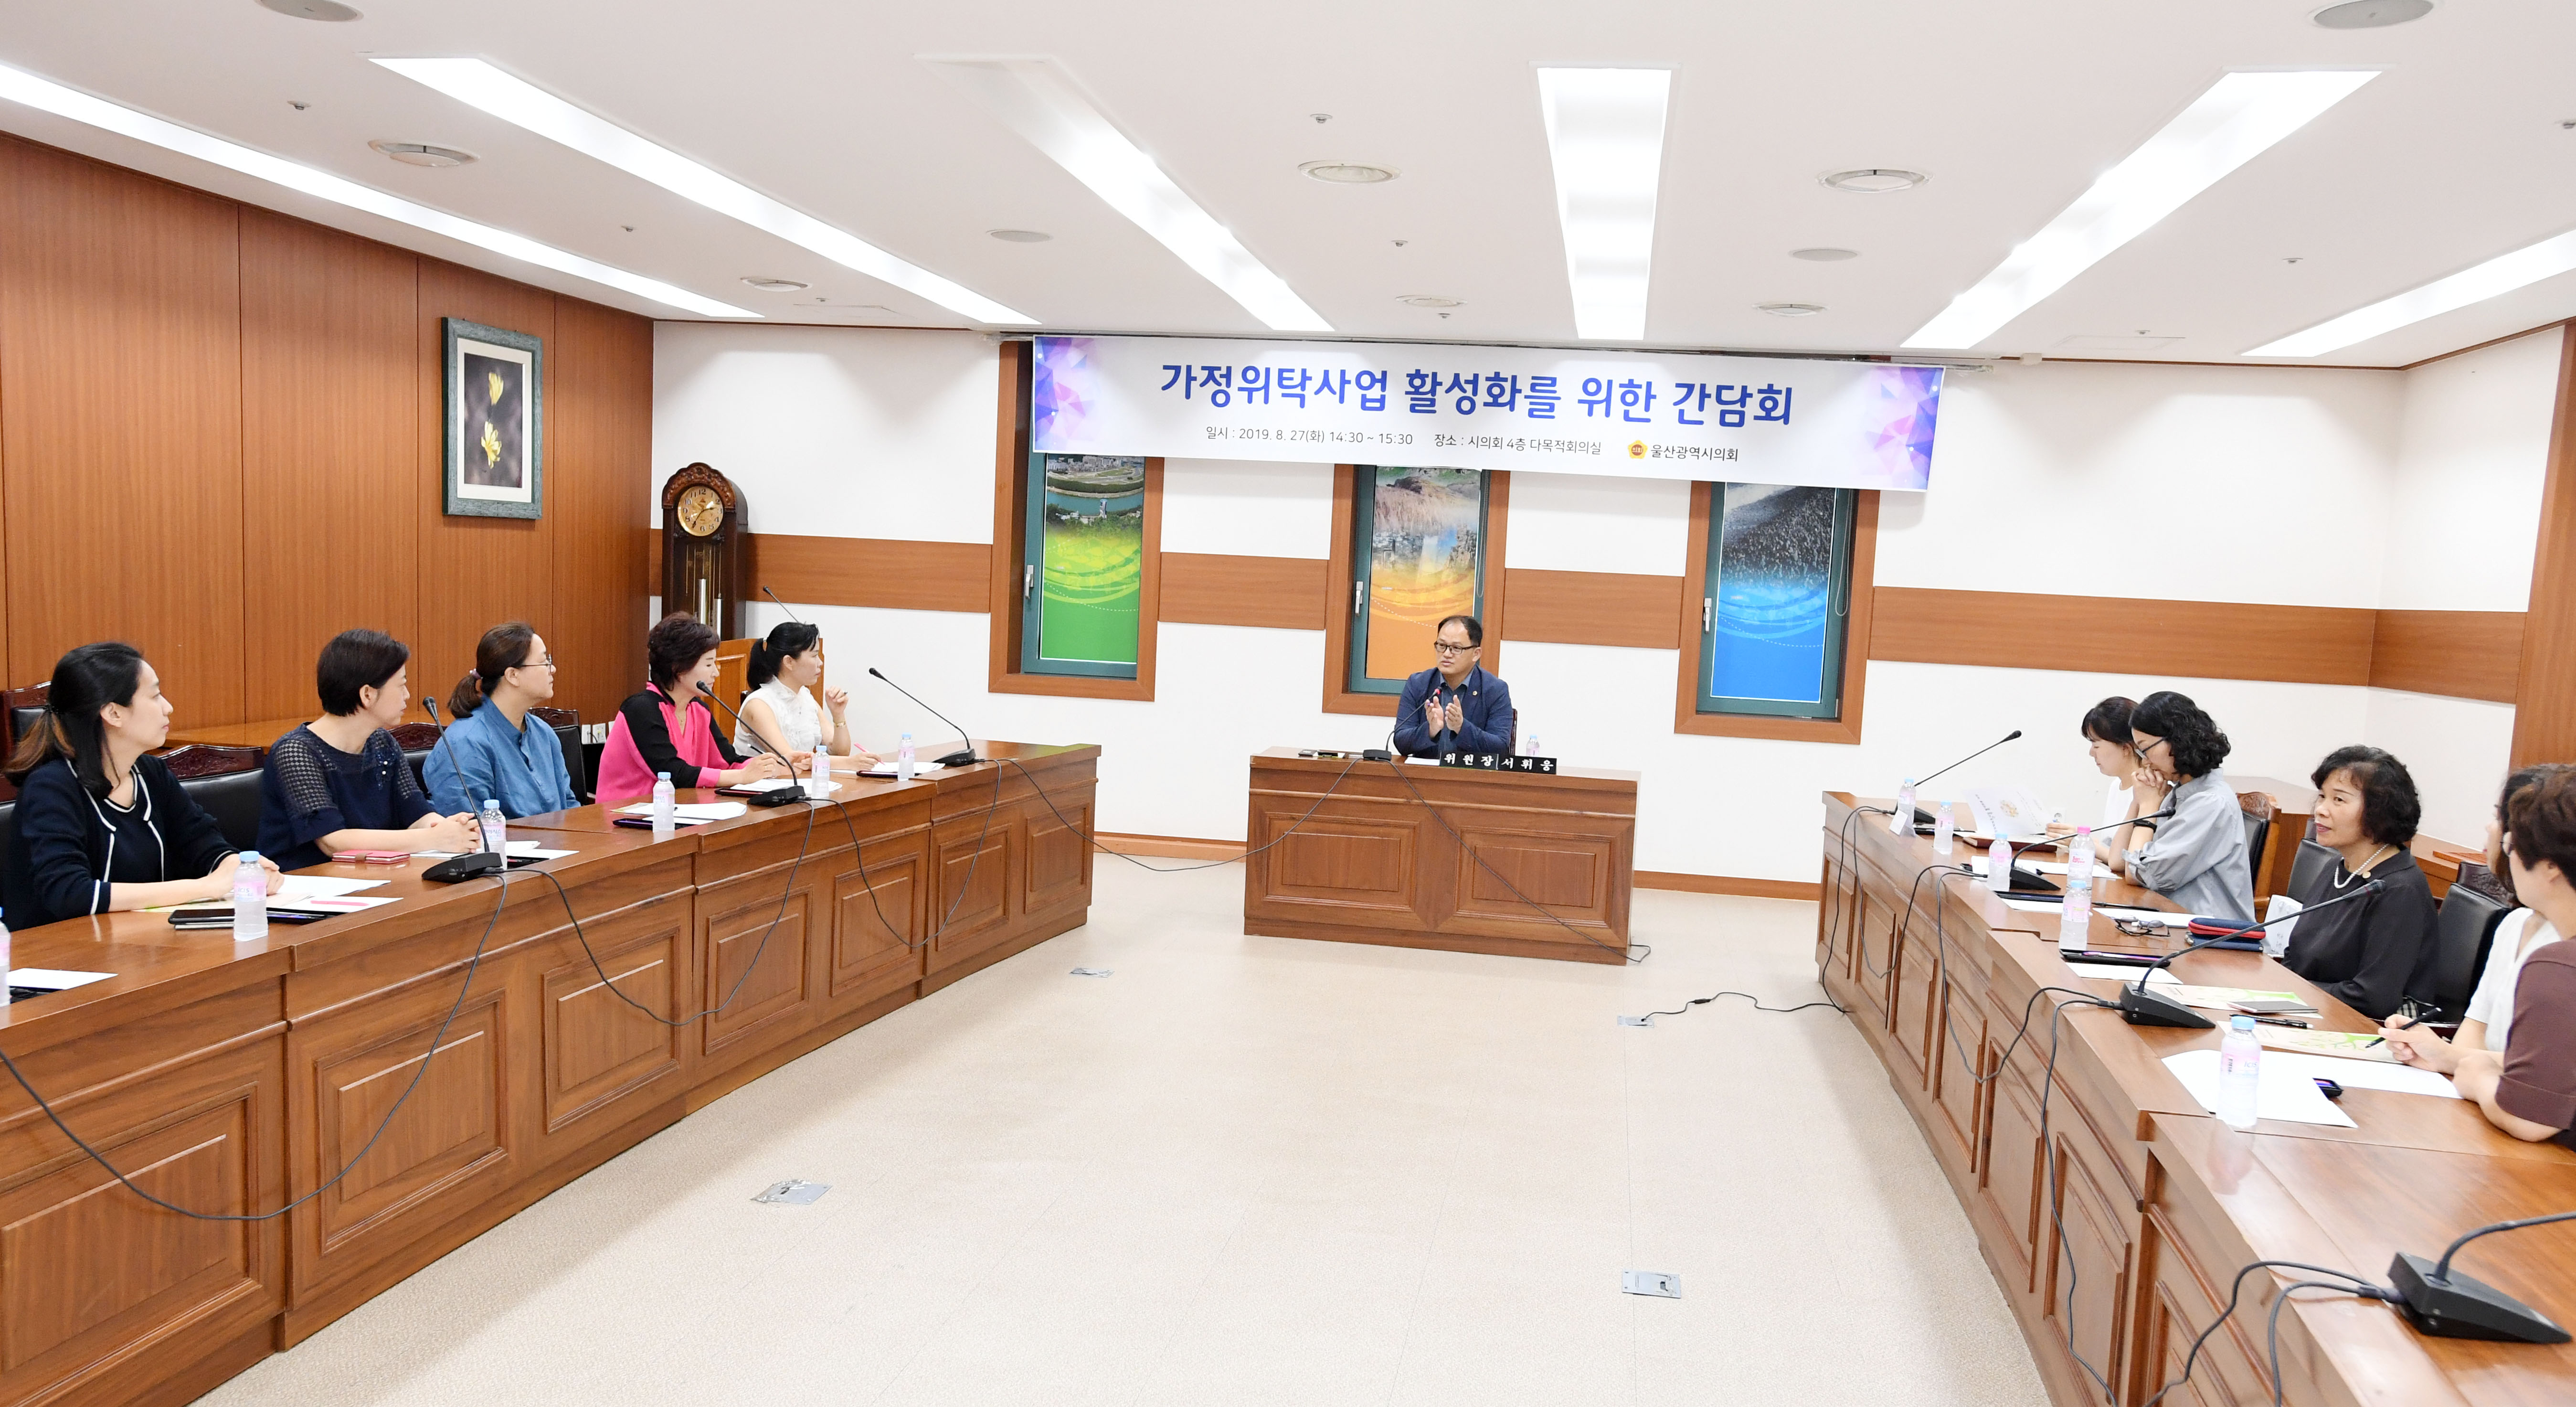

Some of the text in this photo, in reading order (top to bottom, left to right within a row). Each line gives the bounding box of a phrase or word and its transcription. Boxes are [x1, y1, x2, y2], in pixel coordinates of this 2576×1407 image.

[1162, 365, 1792, 427] 가정위탁사업 활성화를 위한 간담회
[1206, 426, 1228, 440] 일시
[1239, 428, 1272, 440] 2019.
[1276, 429, 1286, 441] 8.
[1290, 430, 1325, 443] 27(화)
[1329, 431, 1363, 443] 14:30
[1378, 433, 1413, 445] 15:30
[1434, 433, 1457, 448] 장소
[1467, 435, 1503, 450] 시의회
[1506, 437, 1527, 451] 4층
[1530, 438, 1601, 455] 다목적회의실
[1651, 444, 1739, 462] 울산광역시의회
[1444, 753, 1494, 767] 위원장
[1501, 757, 1554, 771] 서휘웅
